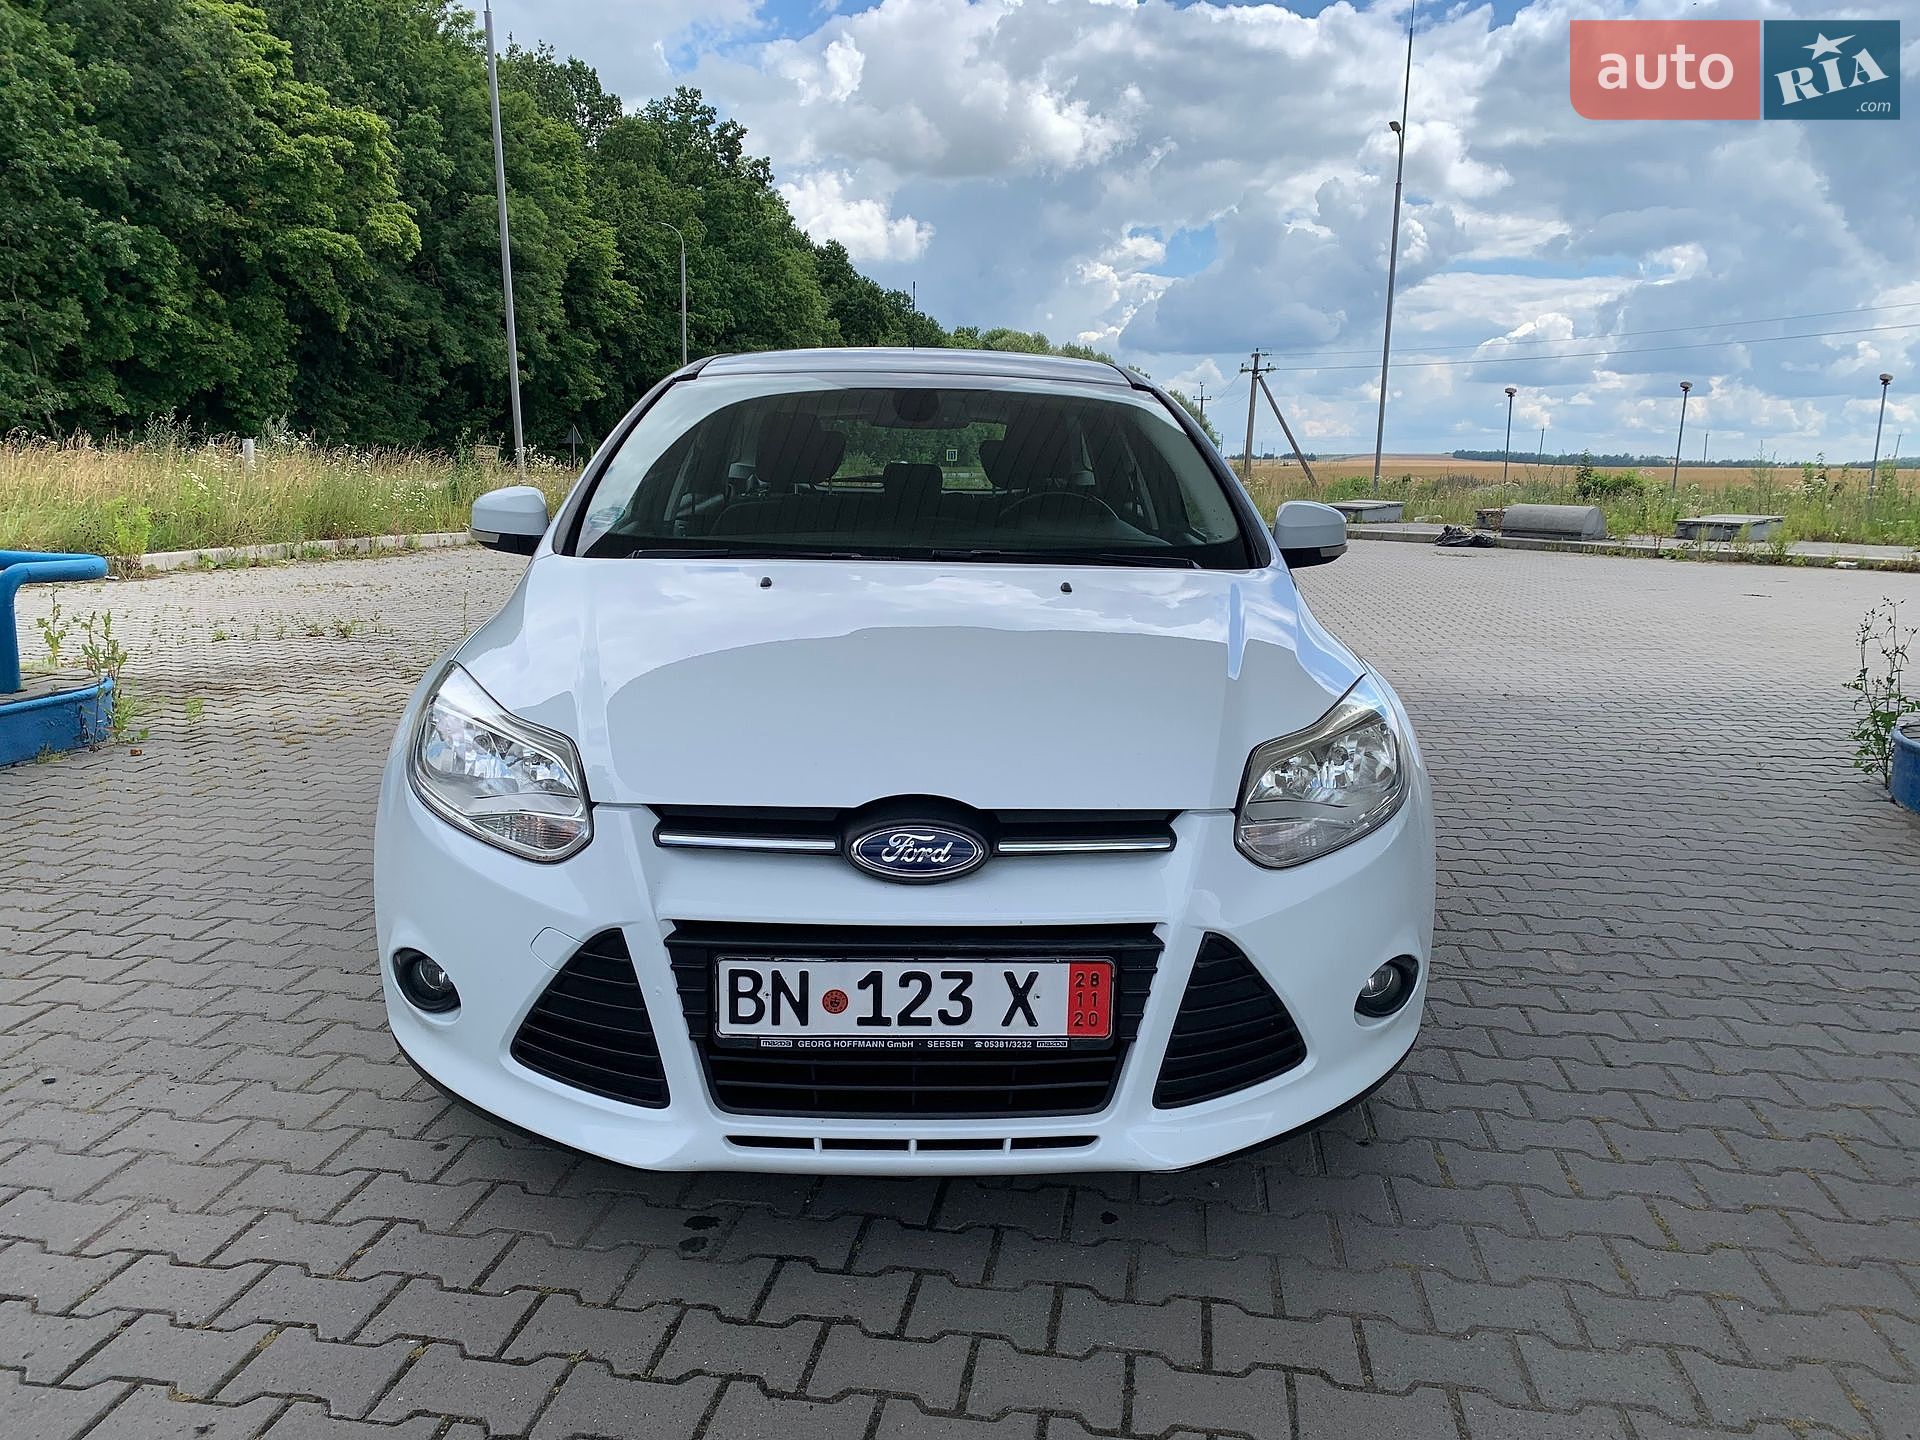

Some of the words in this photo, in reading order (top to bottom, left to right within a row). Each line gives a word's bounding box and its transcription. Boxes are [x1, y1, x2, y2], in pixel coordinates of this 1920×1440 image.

[881, 833, 953, 863] Ford
[1075, 971, 1100, 988] 28
[728, 968, 809, 1026] BN
[856, 970, 973, 1027] 123
[1001, 971, 1039, 1027] X
[1077, 991, 1098, 1008] 11
[1073, 1011, 1098, 1027] 20
[798, 1040, 831, 1048] GEORG
[833, 1040, 885, 1048] HOFFMANN
[887, 1040, 914, 1048] GmbH
